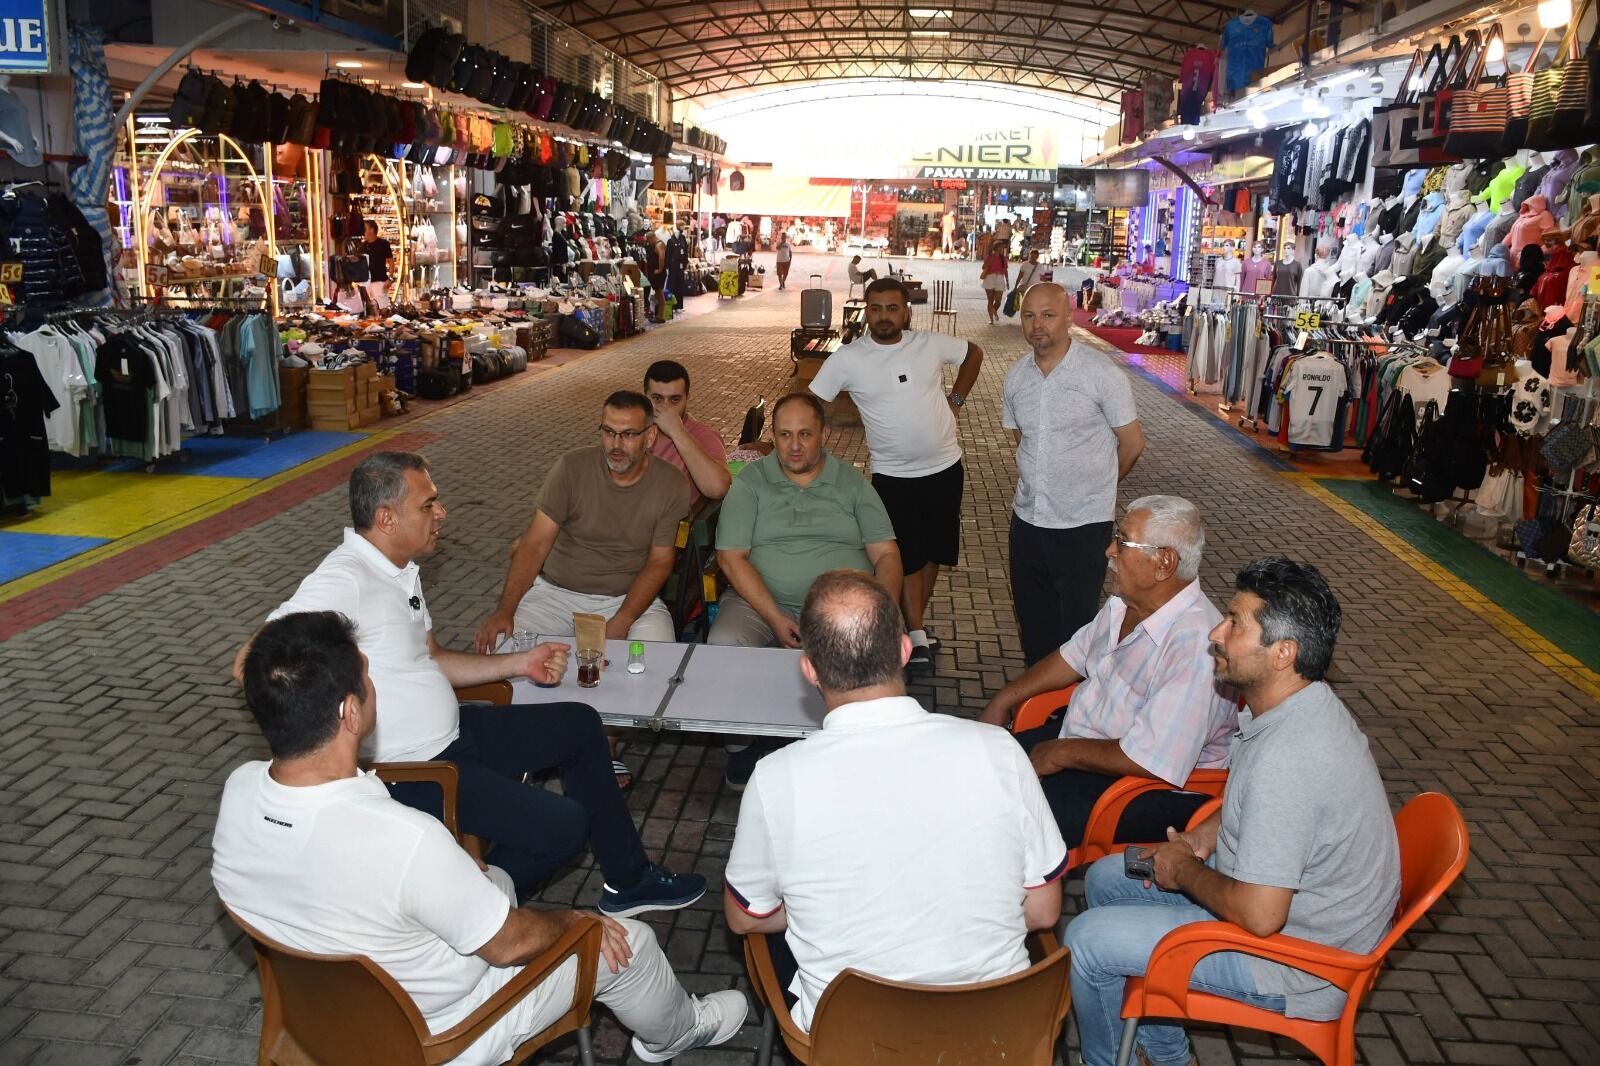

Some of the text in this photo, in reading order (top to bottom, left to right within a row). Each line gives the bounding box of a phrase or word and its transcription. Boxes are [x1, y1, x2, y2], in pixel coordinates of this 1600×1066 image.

[924, 167, 976, 178] РАХАТ
[976, 168, 1029, 180] ЛУКУМ
[1296, 312, 1319, 328] 5€
[1302, 373, 1331, 382] RONALDO
[1308, 385, 1324, 416] 7
